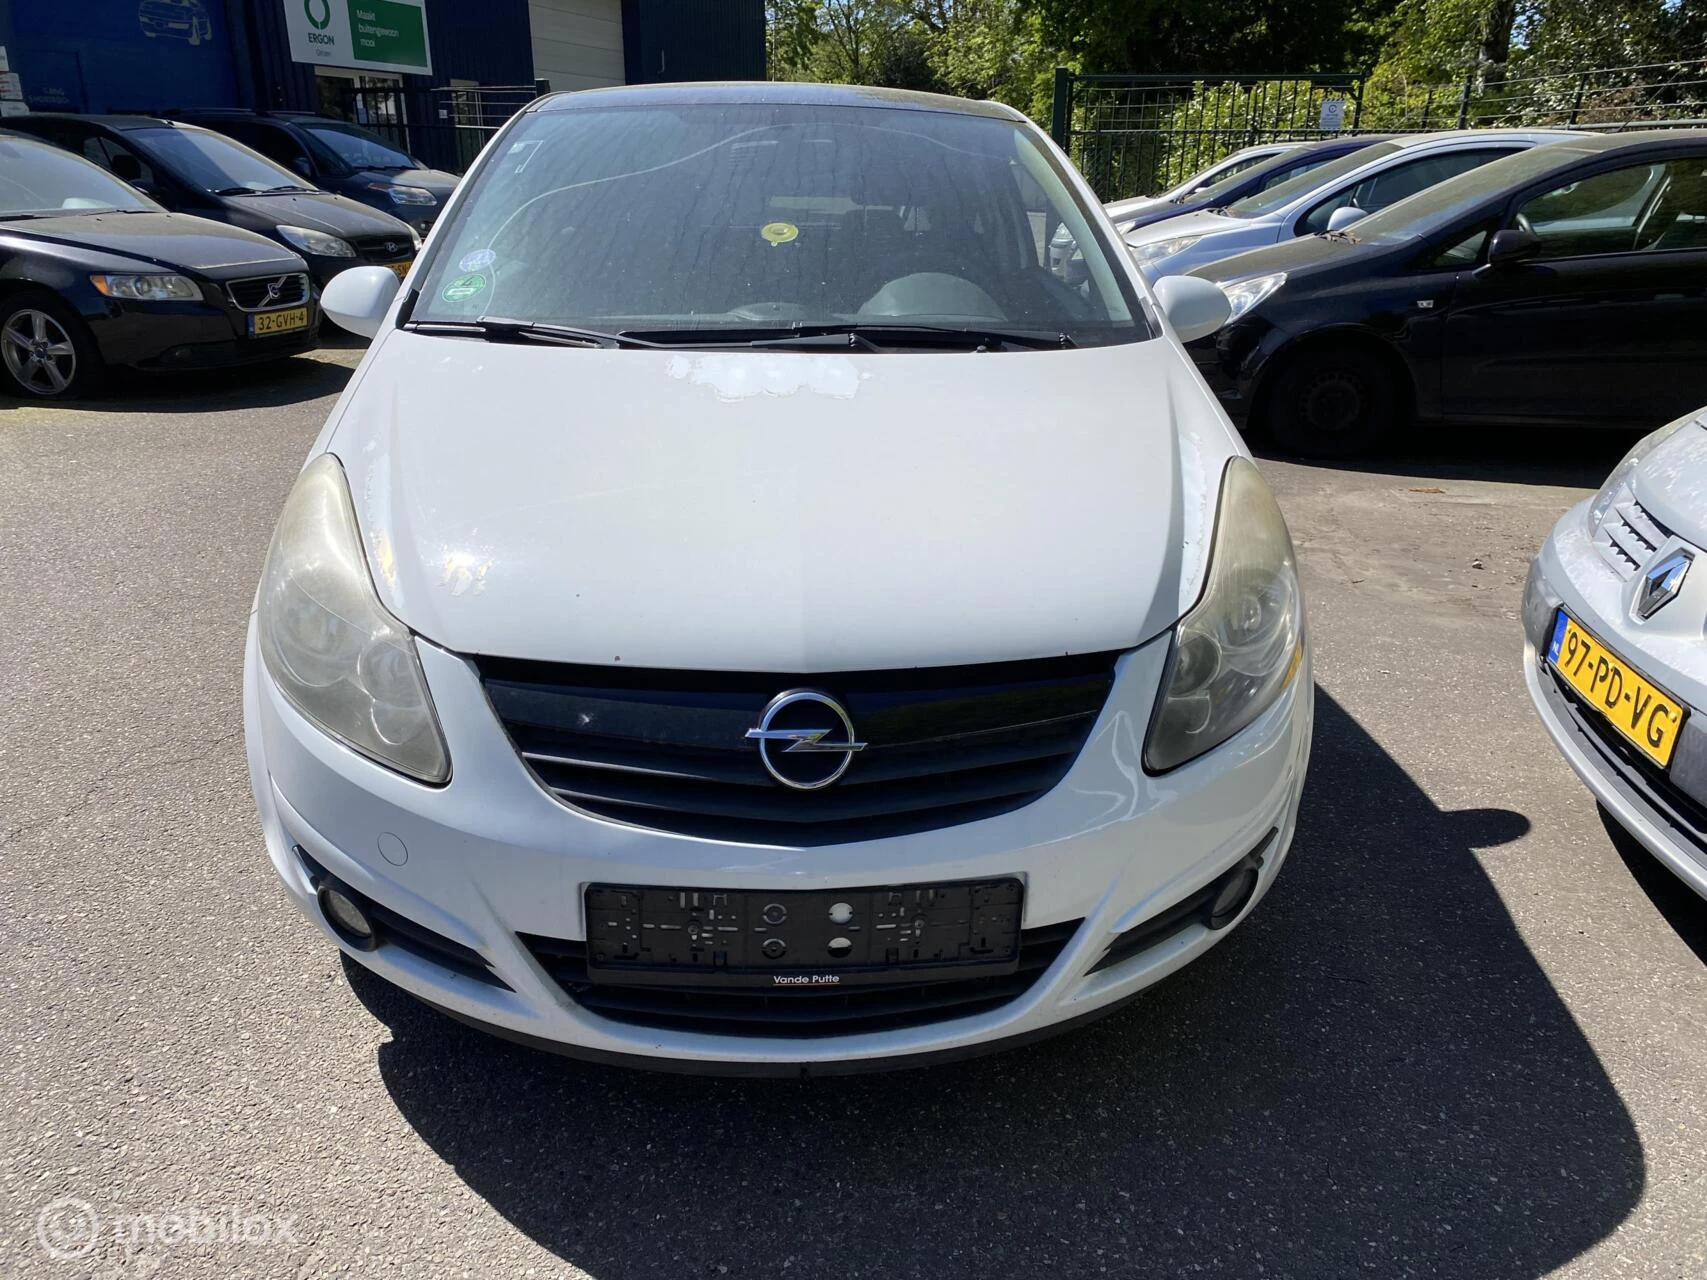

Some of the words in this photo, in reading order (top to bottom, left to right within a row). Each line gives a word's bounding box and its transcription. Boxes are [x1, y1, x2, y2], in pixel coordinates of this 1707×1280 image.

[307, 32, 335, 46] ERGON
[258, 311, 304, 331] 32-GVH-4
[1564, 632, 1669, 749] 97-PD-VG
[773, 975, 810, 984] Vande
[812, 975, 840, 983] Putte
